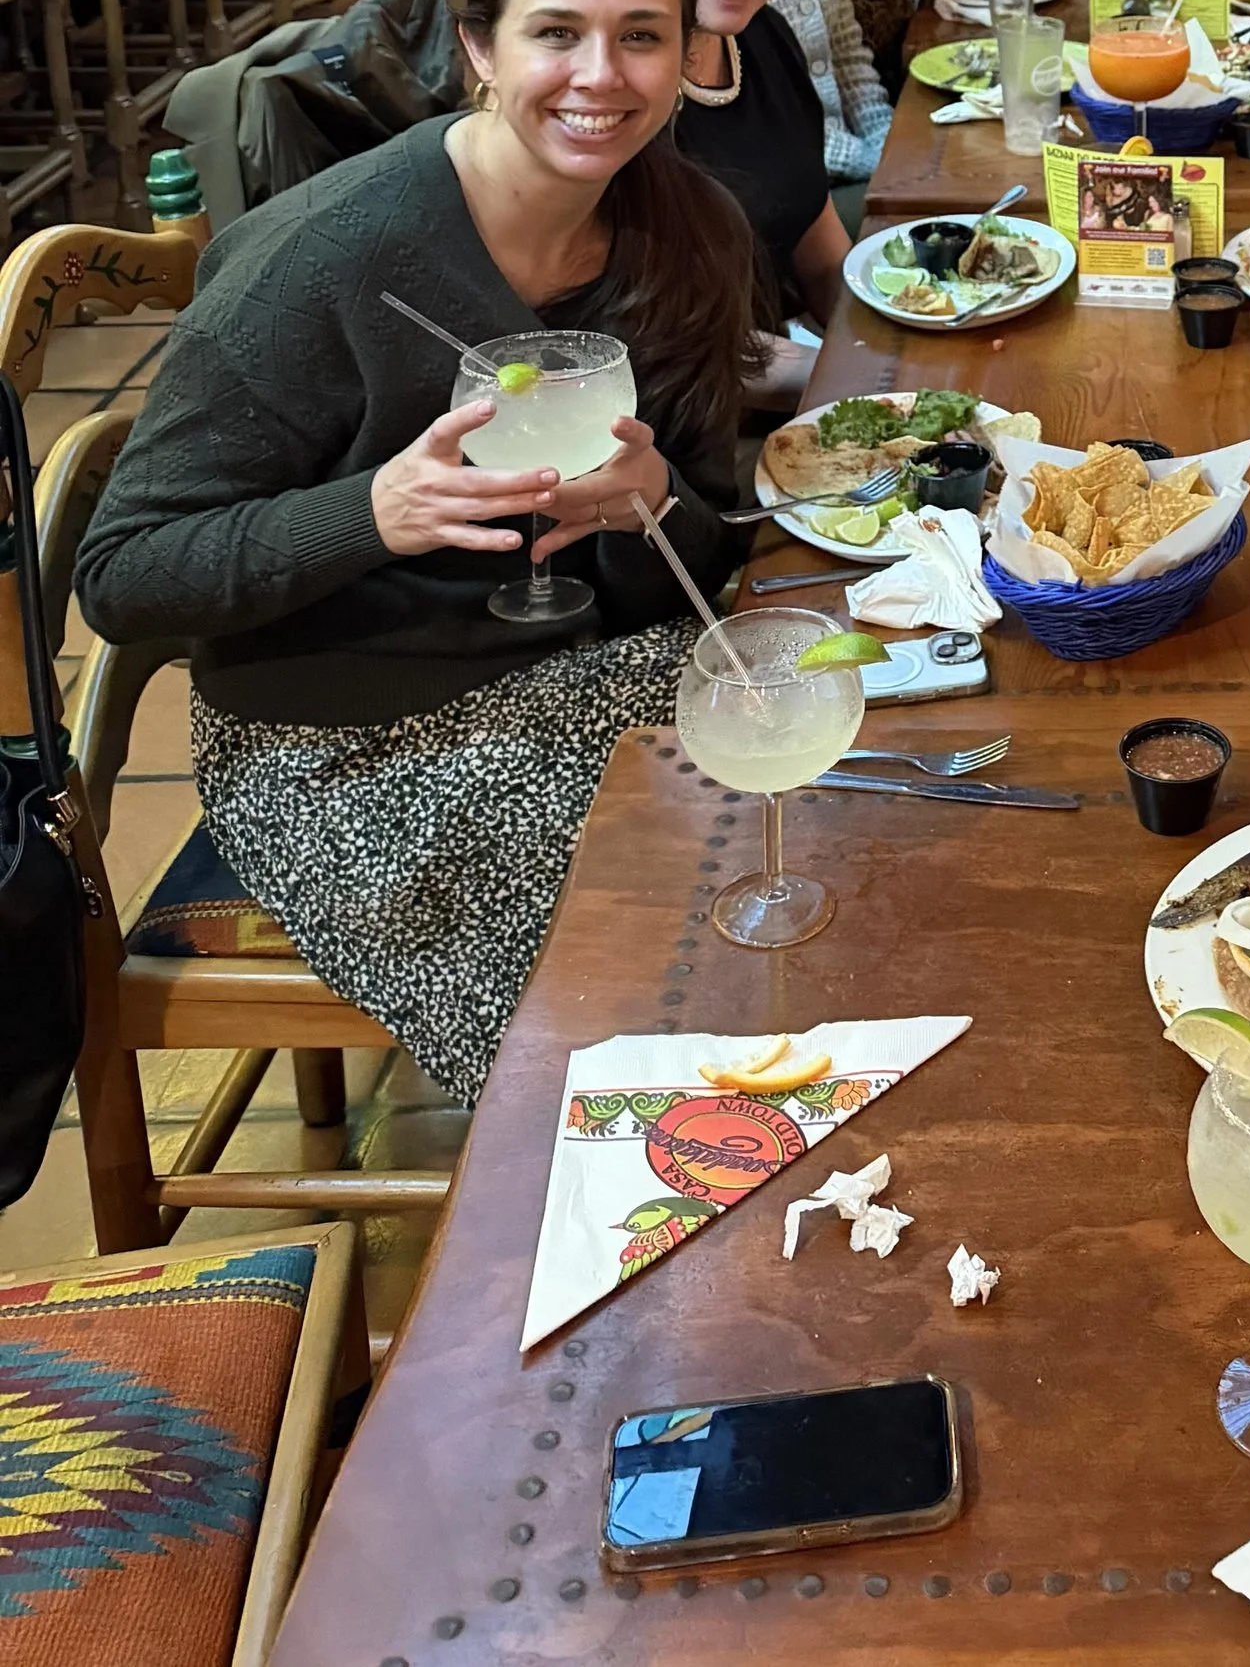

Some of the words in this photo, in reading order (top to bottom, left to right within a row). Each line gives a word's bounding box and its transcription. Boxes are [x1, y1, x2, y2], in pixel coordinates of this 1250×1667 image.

[716, 1099, 776, 1125] TOWN
[776, 1123, 802, 1156] OLD
[661, 1162, 711, 1197] CASA
